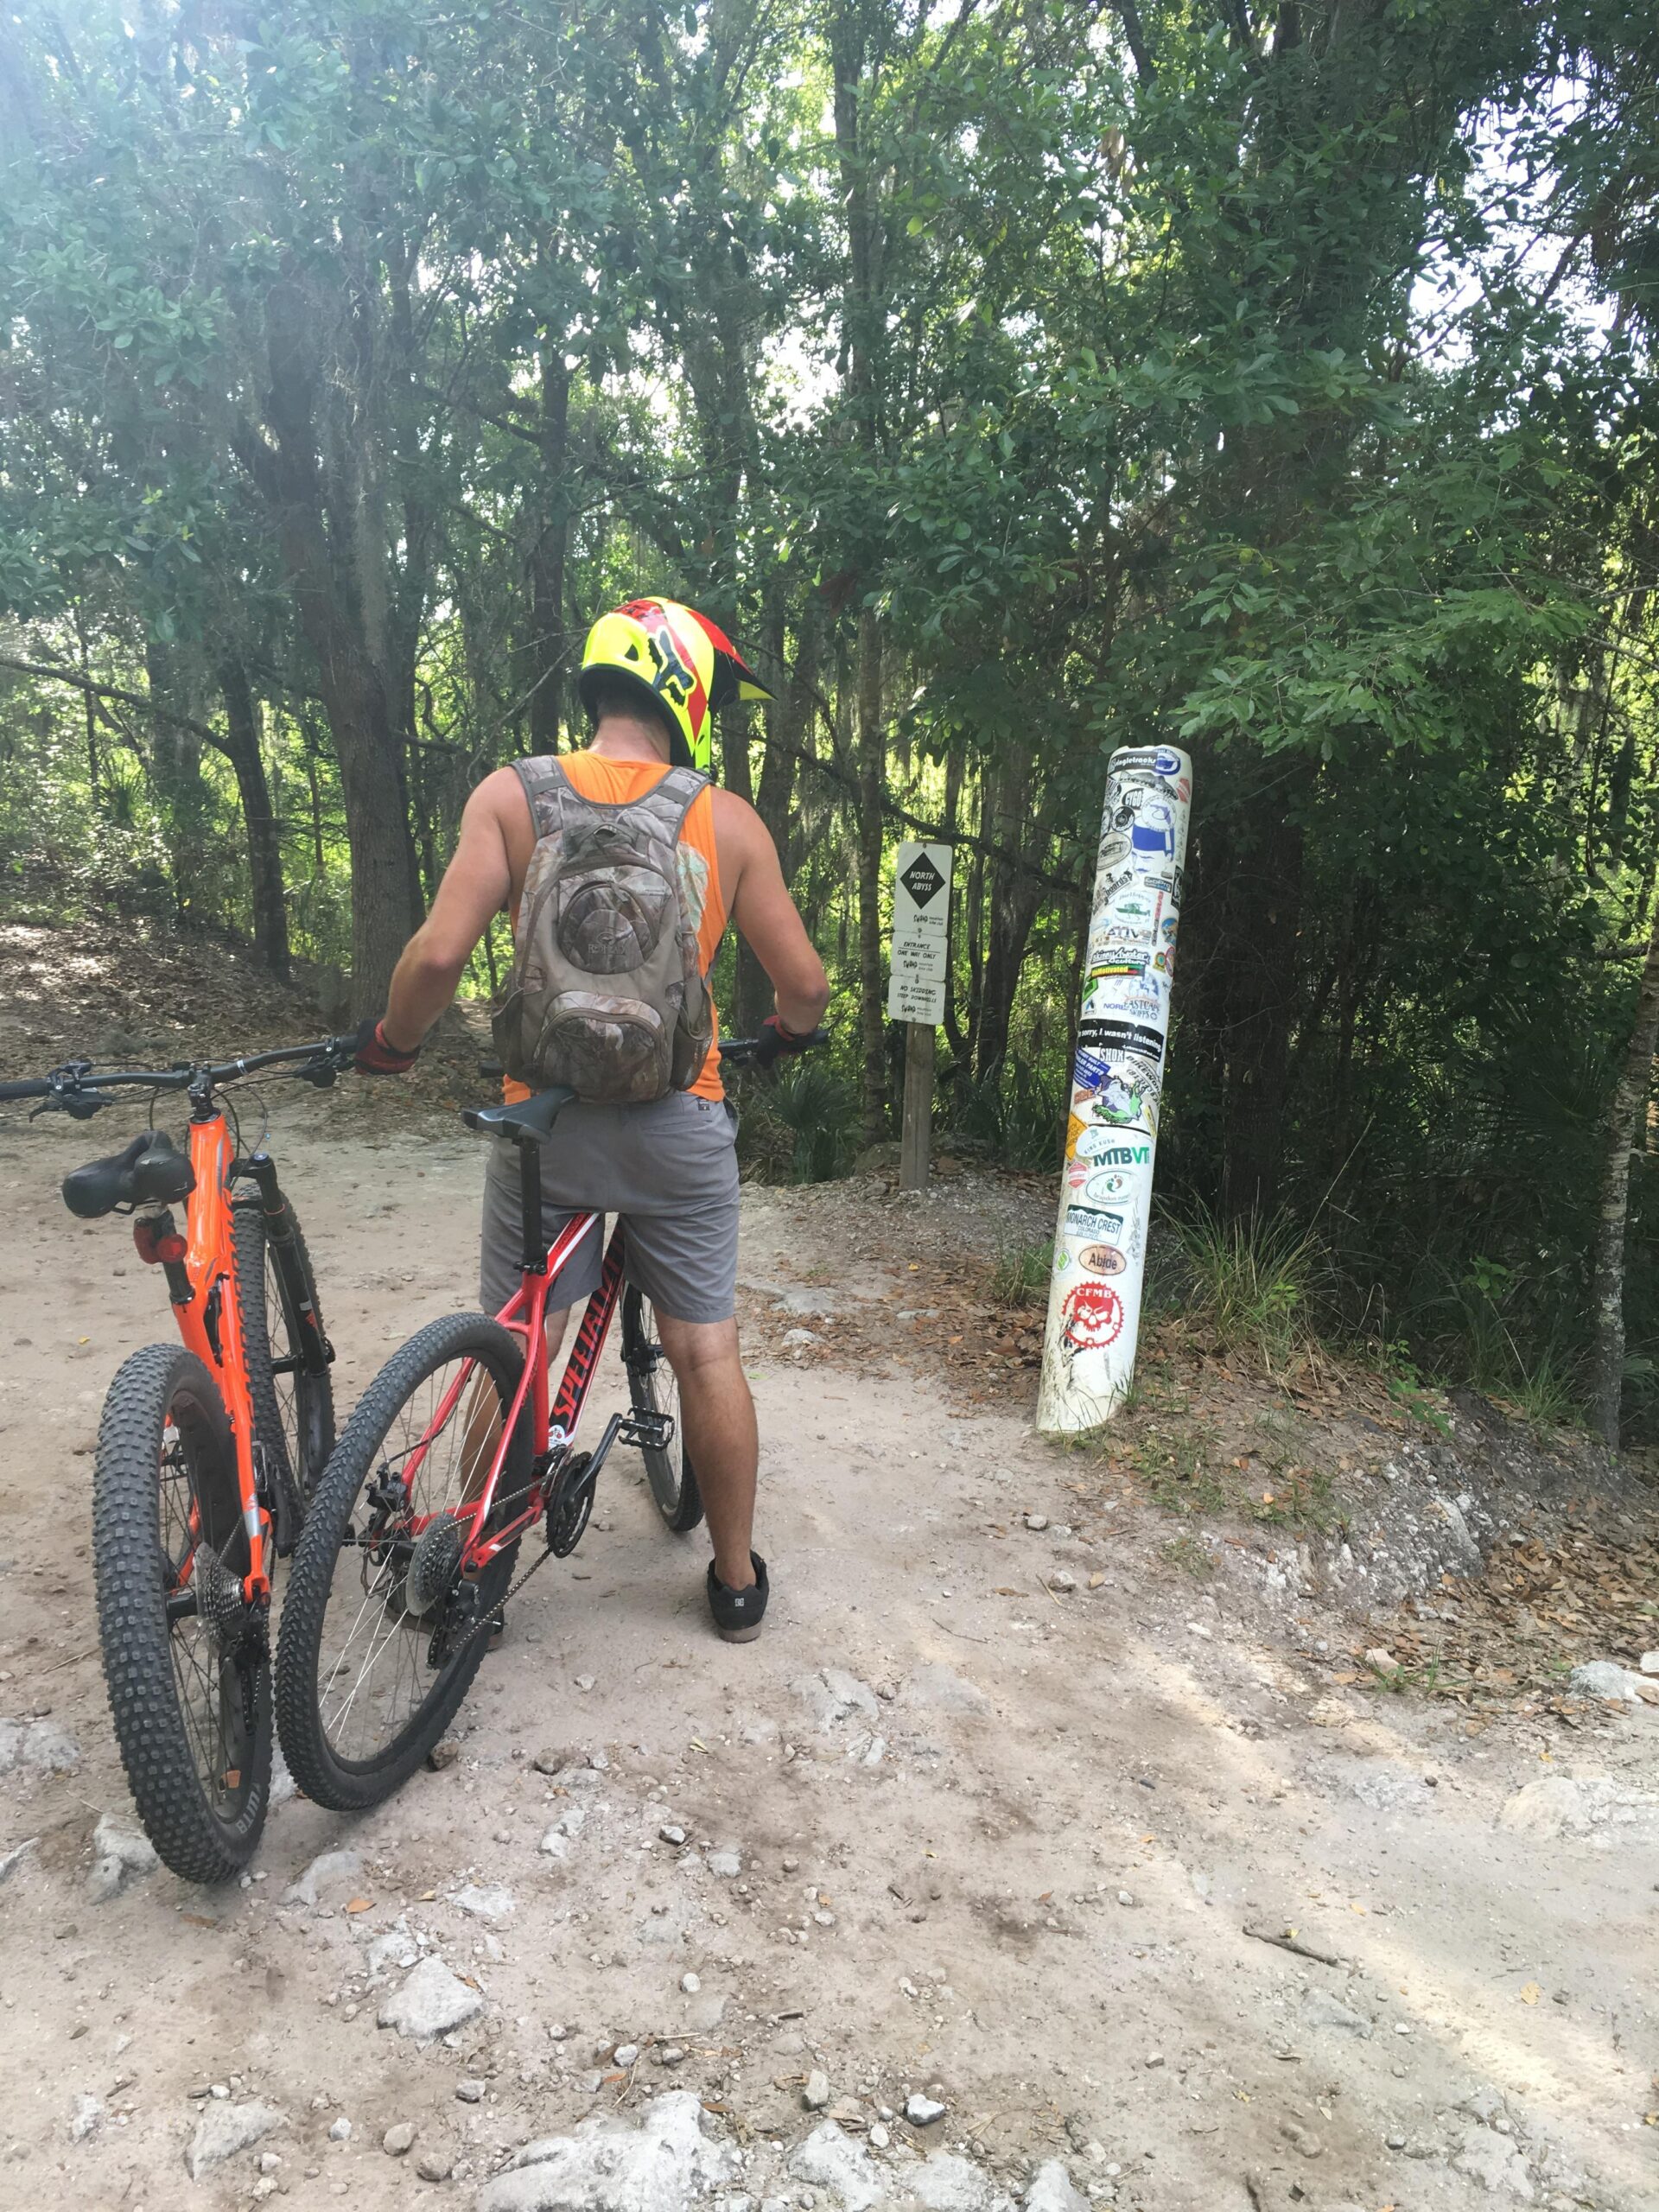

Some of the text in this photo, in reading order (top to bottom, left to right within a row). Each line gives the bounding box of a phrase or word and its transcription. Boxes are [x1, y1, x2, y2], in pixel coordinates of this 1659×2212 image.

[910, 871, 935, 880] NORTH
[912, 882, 931, 891] ABYSS
[911, 987, 937, 995] SKIDDING
[1104, 1030, 1132, 1039] wasn't
[1100, 1048, 1124, 1062] SHOX
[1084, 1062, 1104, 1076] PARTS
[1066, 1211, 1122, 1235] MONARCH CREST
[1089, 1253, 1117, 1269] Abide
[1076, 1287, 1112, 1299] CFMB
